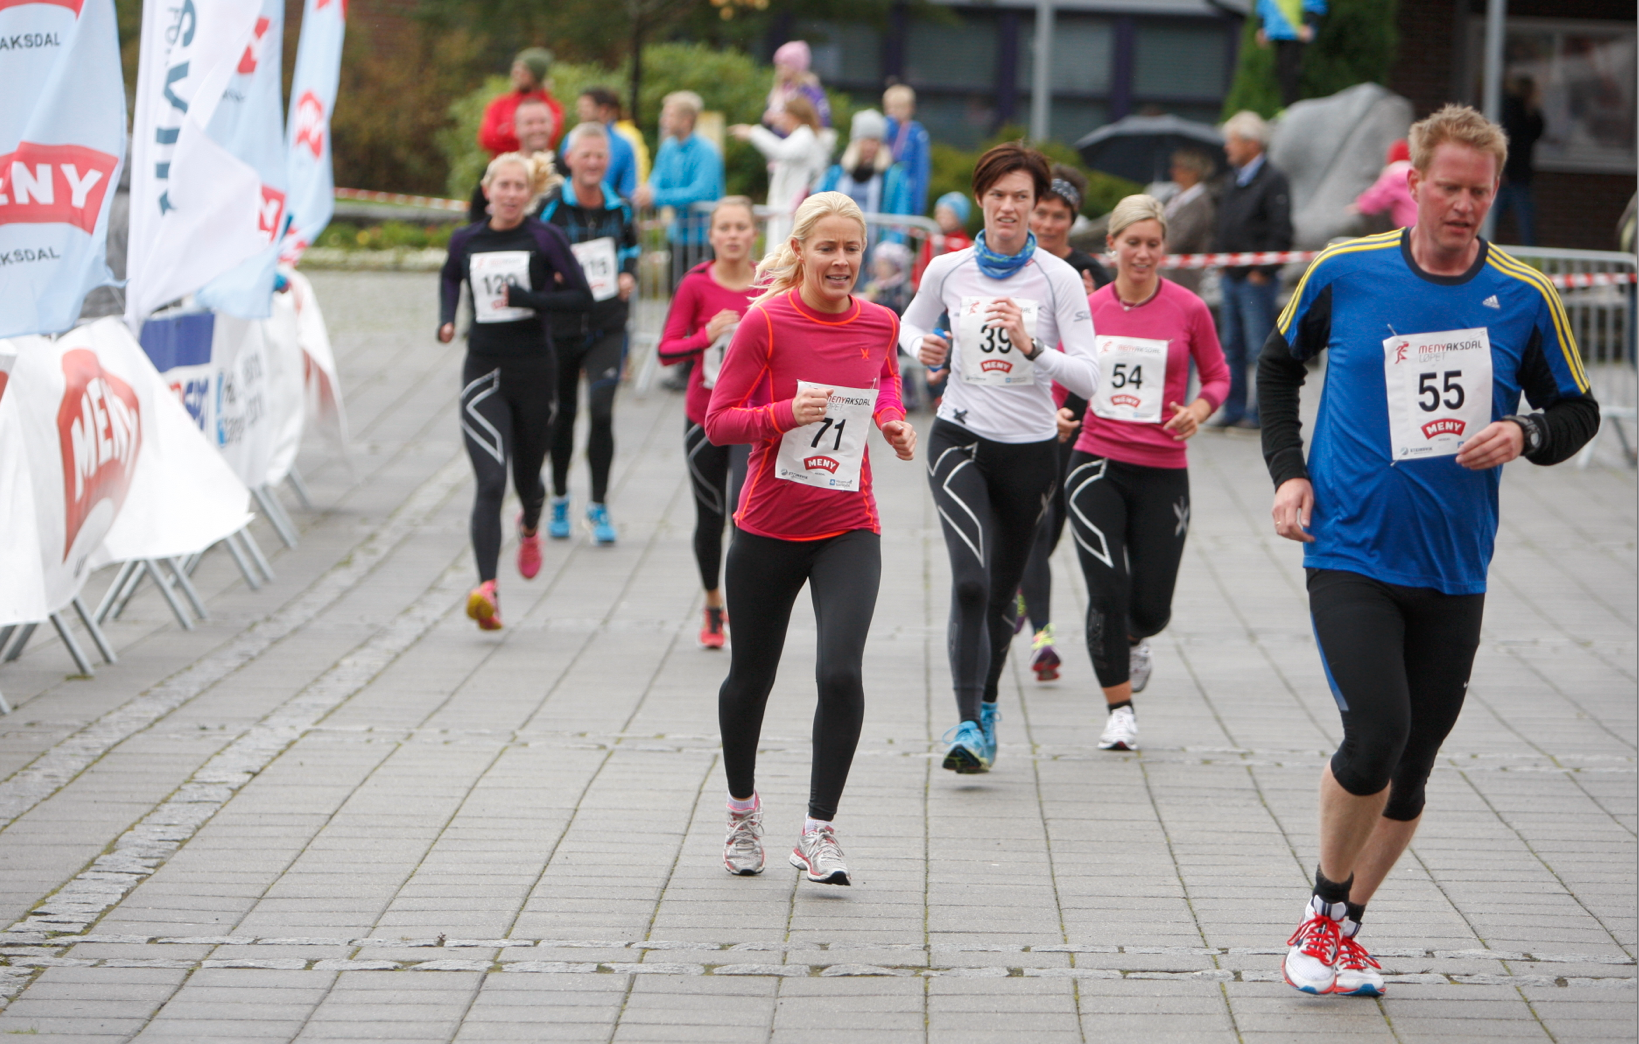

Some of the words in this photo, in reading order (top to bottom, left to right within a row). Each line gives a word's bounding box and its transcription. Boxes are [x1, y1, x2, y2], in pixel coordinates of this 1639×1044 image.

[980, 323, 1013, 354] 39
[1418, 341, 1483, 355] MENYAKSDAL
[982, 360, 1011, 371] MENY
[1111, 363, 1143, 390] 54
[1417, 370, 1465, 413] 55
[1112, 396, 1139, 406] MENY
[811, 417, 847, 451] 71
[1425, 421, 1463, 436] MENY
[807, 458, 837, 471] MENY
